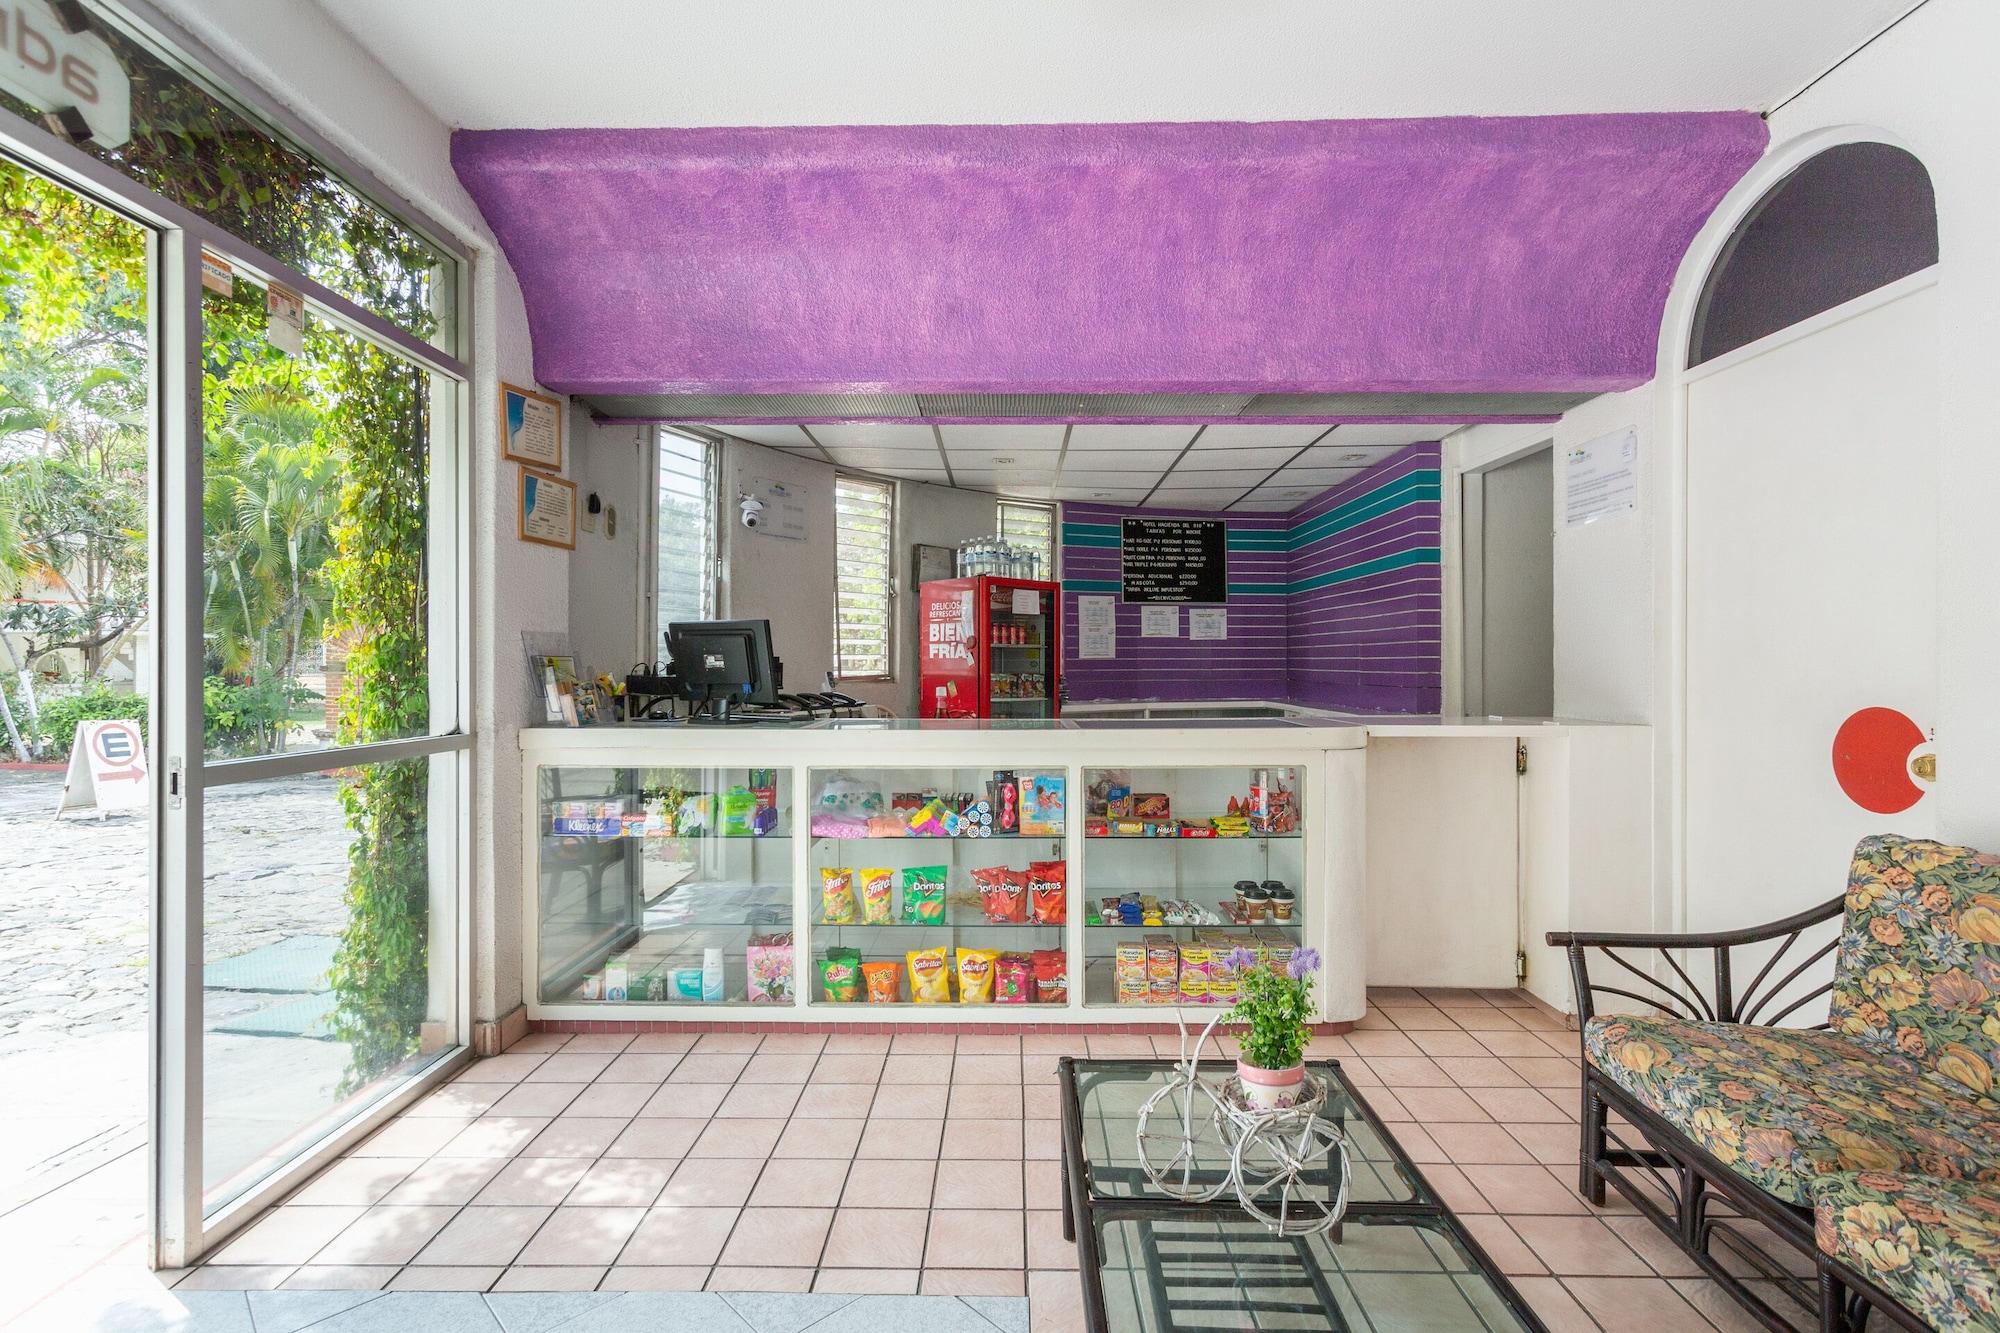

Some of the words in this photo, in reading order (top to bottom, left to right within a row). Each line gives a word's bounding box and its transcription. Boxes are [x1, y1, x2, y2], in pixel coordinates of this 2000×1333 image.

[932, 602, 961, 610] DELICIOS
[102, 733, 131, 757] E
[568, 818, 604, 833] Kleenex
[913, 882, 945, 892] Doritos
[1031, 881, 1062, 891] Doritos
[914, 957, 944, 969] Sabritas
